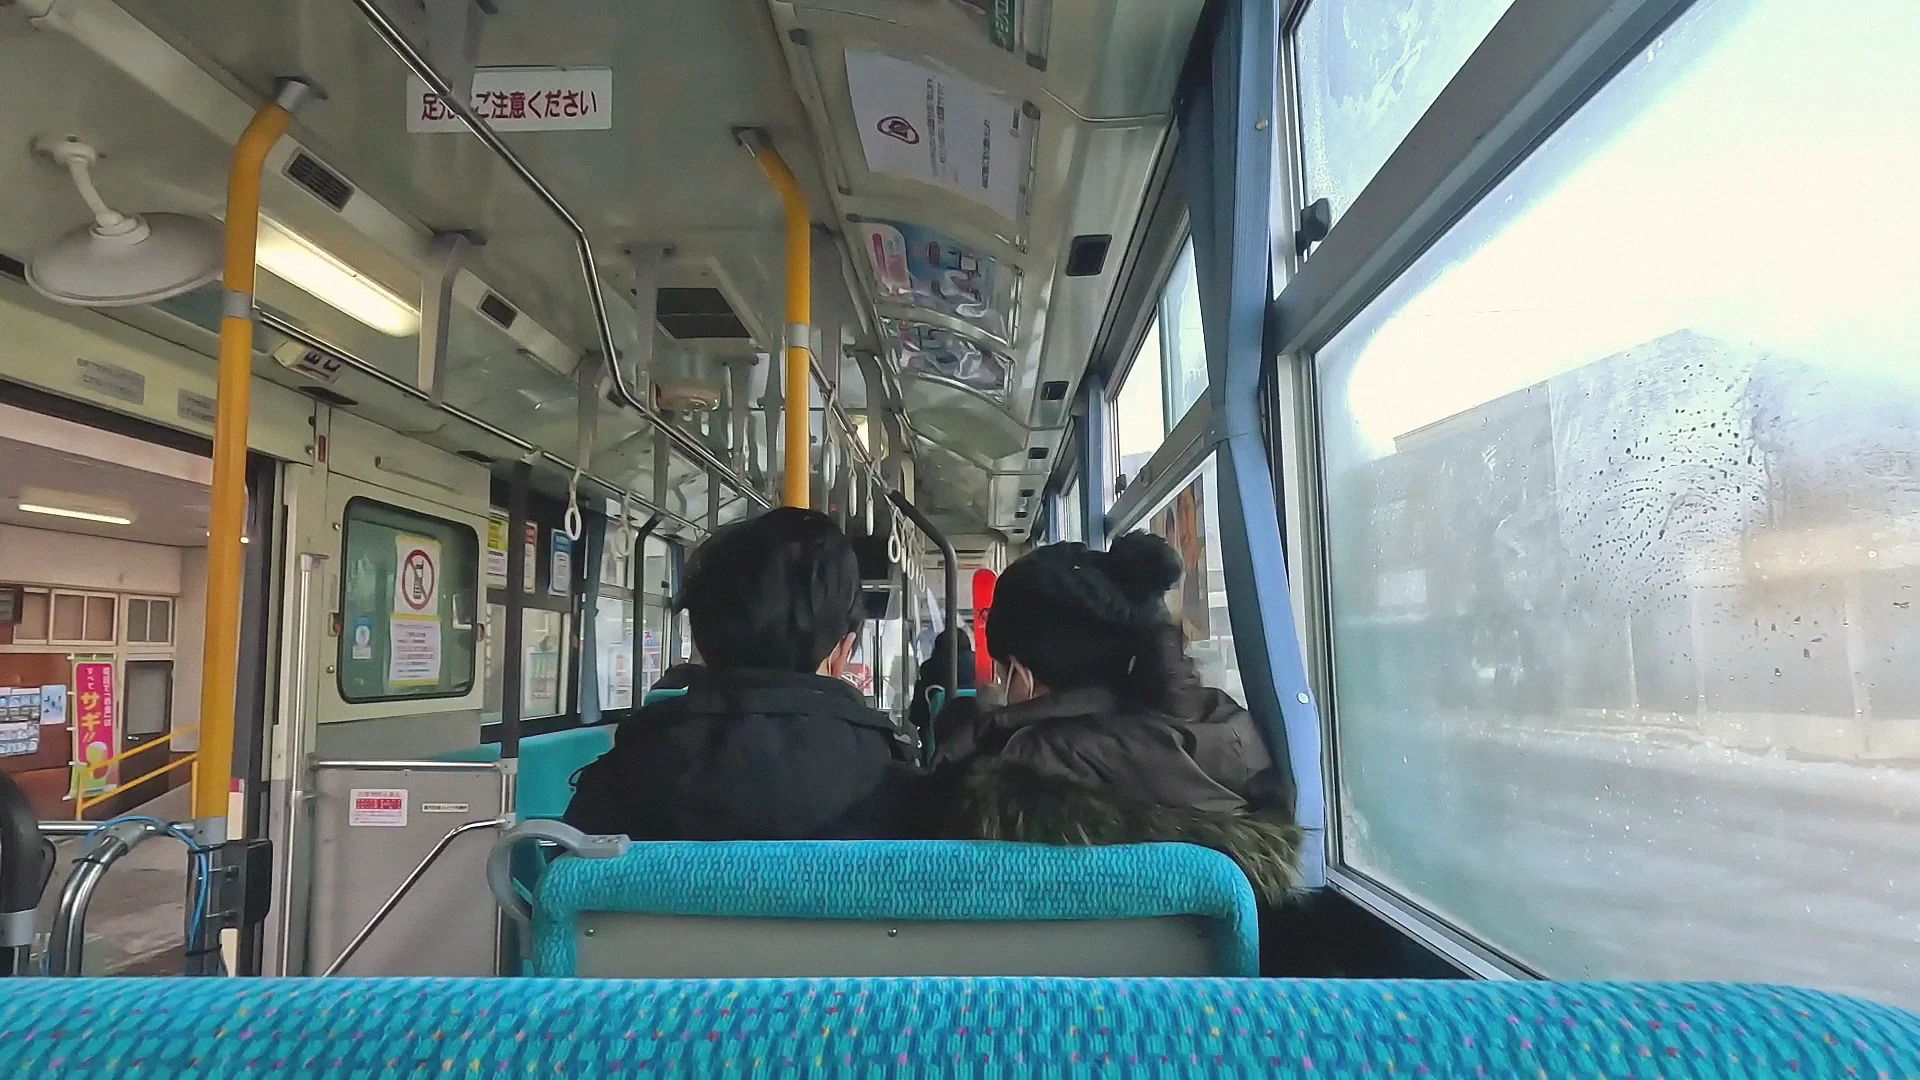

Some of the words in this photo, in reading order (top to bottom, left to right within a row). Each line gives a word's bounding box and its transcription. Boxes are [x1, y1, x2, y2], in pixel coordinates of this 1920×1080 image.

[421, 90, 597, 120] 足ご注意ください
